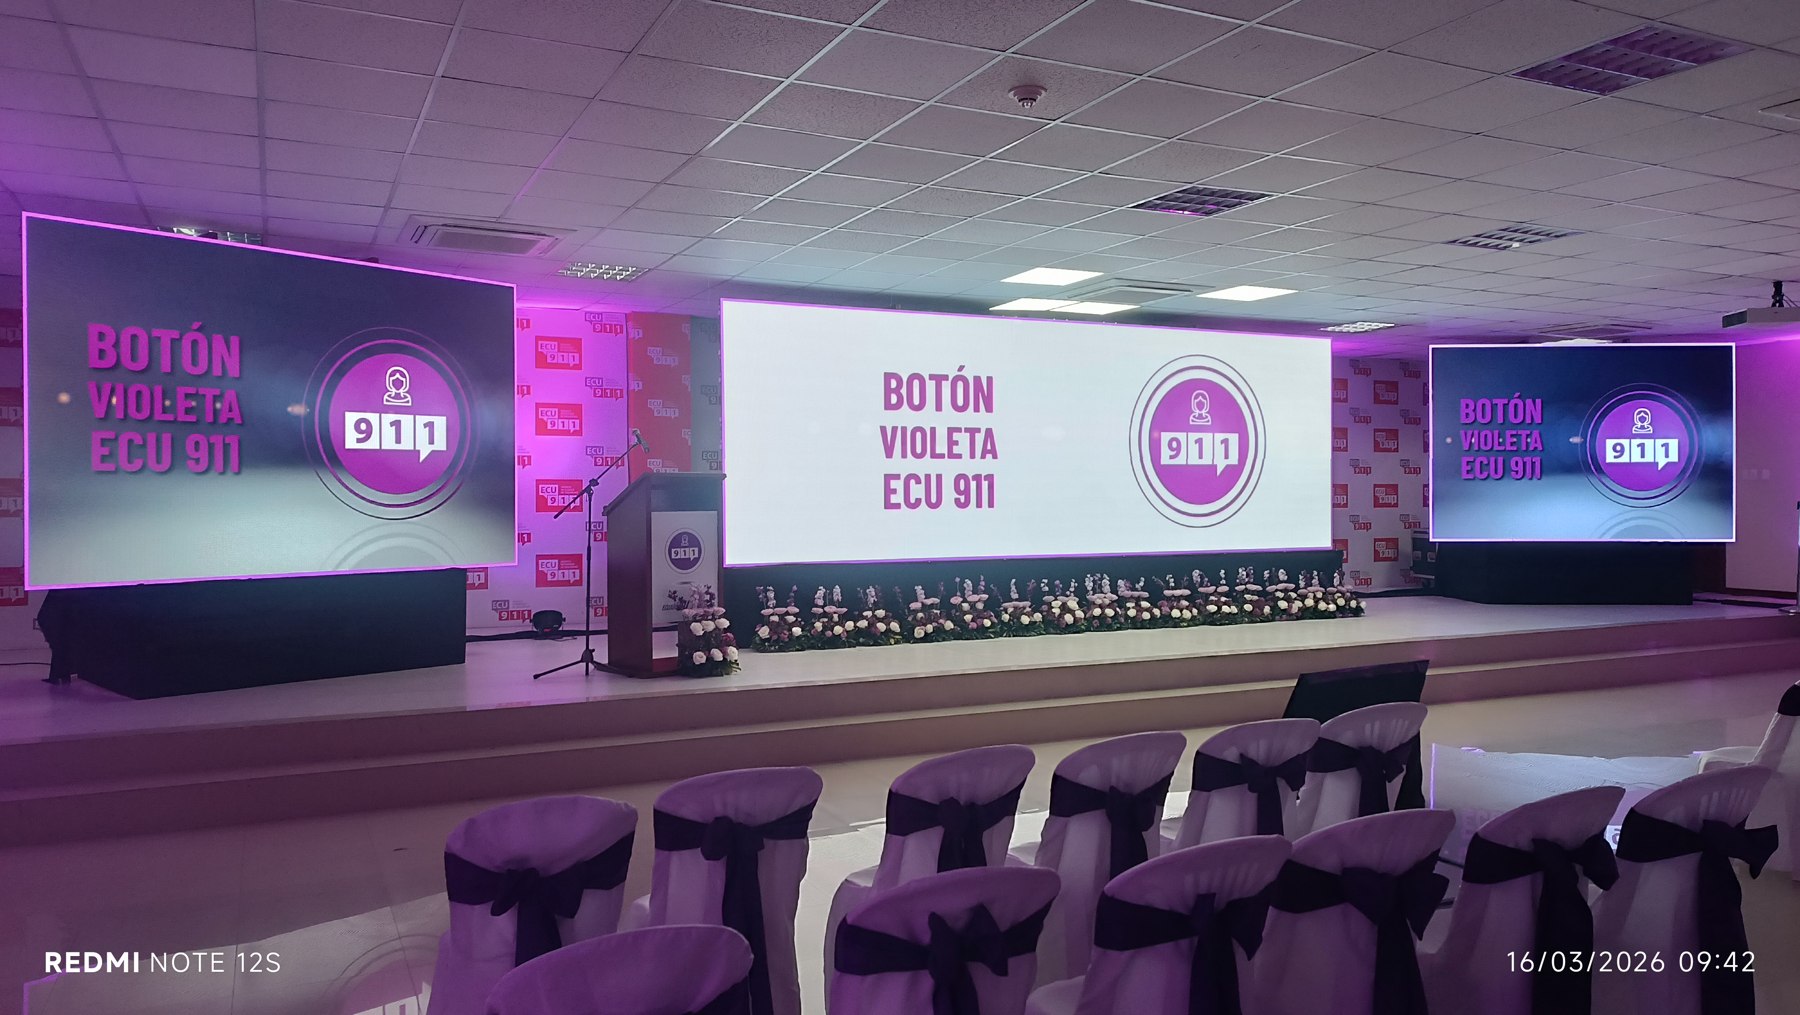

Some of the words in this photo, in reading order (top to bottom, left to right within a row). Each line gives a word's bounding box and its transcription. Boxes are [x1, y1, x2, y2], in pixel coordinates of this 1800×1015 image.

[595, 323, 621, 333] 911
[88, 322, 241, 378] BOTÓN
[540, 343, 557, 351] ECU
[549, 353, 577, 362] 911
[595, 389, 621, 398] 911
[883, 365, 994, 413] BOTÓN
[88, 381, 243, 424] VIOLETA
[1460, 392, 1542, 423] BOTÓN
[549, 420, 577, 429] 911
[353, 417, 435, 446] 911
[880, 425, 999, 460] VIOLETA
[1461, 430, 1543, 451] VIOLETA
[91, 430, 173, 473] ECU
[185, 433, 240, 473] 911
[587, 447, 603, 455] ECU
[1166, 437, 1231, 461] 911
[1612, 442, 1671, 459] 911
[1461, 457, 1504, 480] ECU
[1510, 457, 1542, 480] 911
[540, 486, 557, 494] ECU
[883, 474, 943, 510] ECU
[953, 474, 995, 509] 911
[673, 548, 696, 558] 911
[540, 561, 557, 569] ECU
[549, 571, 577, 579] 911
[492, 601, 508, 609] ECU
[501, 611, 529, 620] 911
